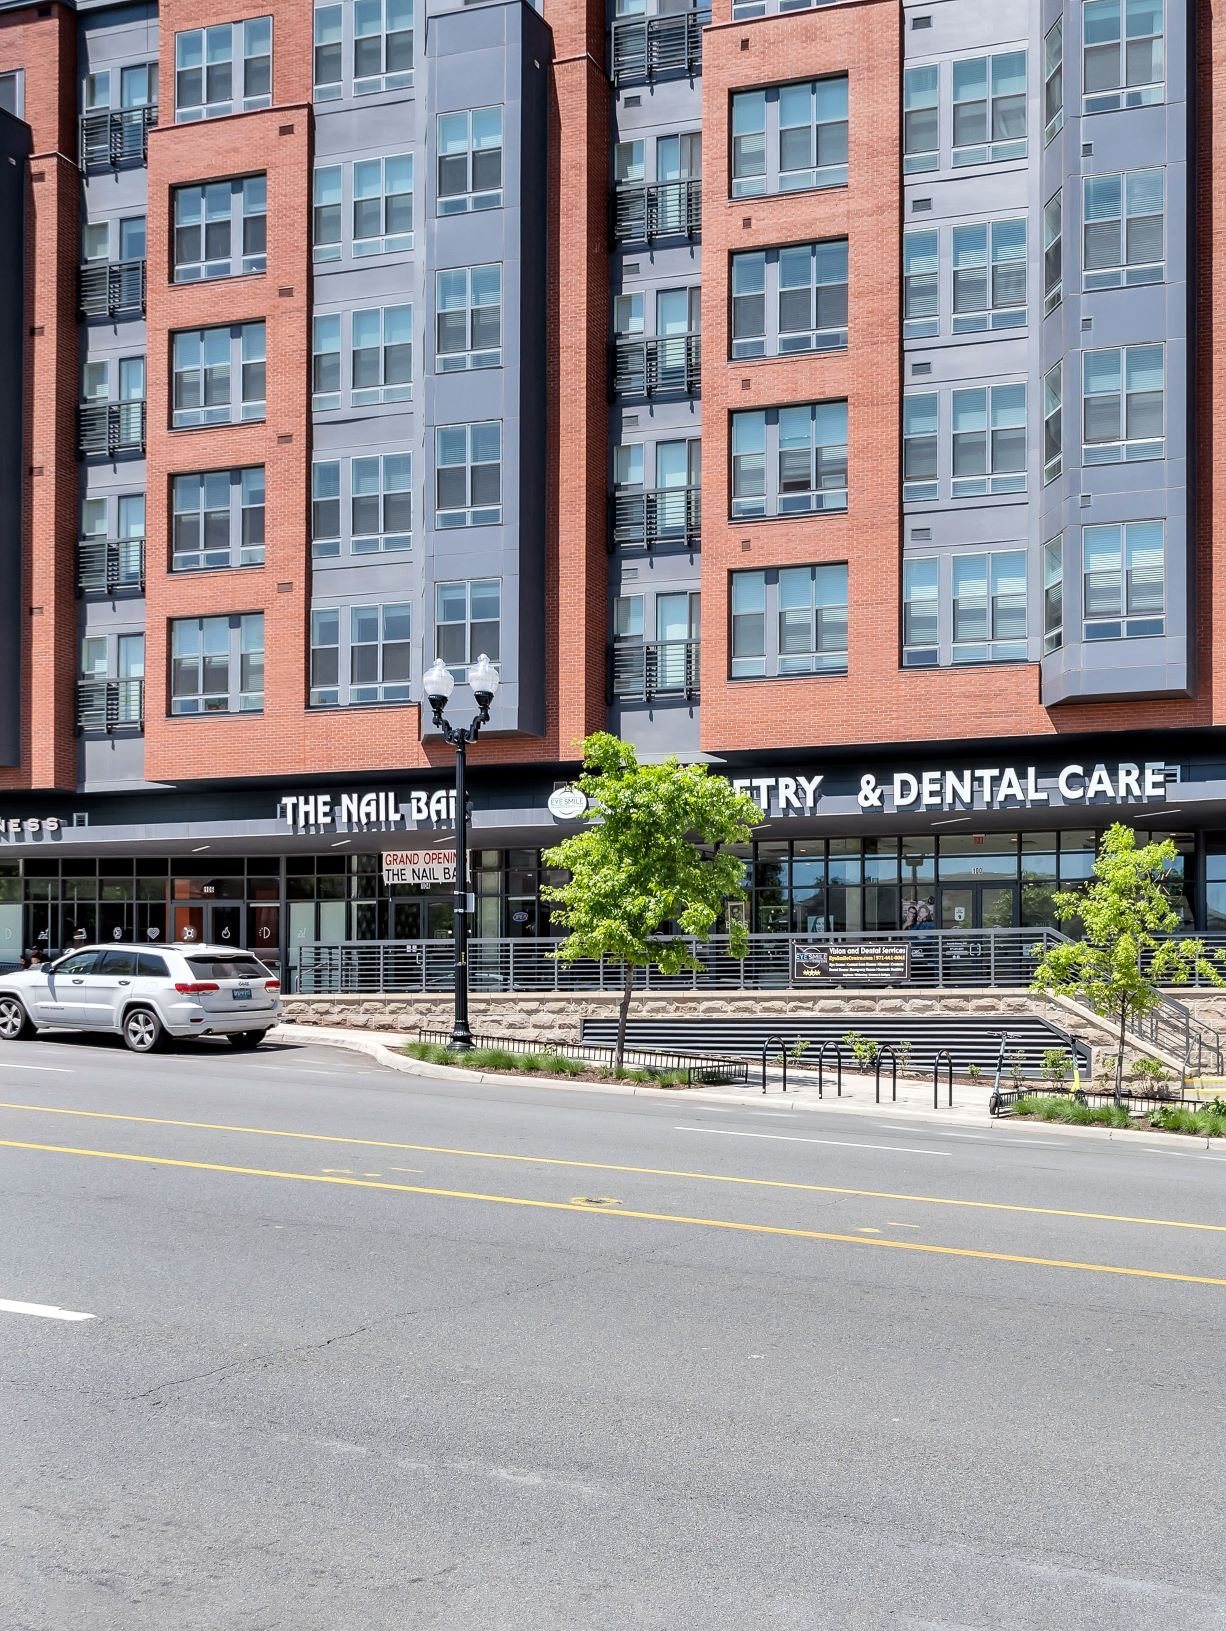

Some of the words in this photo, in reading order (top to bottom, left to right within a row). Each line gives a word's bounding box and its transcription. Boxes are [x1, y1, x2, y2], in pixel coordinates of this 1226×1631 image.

[857, 773, 882, 808] &
[893, 766, 1048, 806] DENTAL
[1058, 761, 1166, 800] CARE
[281, 794, 333, 828] THE
[341, 791, 401, 826] NAIL
[550, 798, 563, 806] EYE
[385, 853, 420, 866] GRAND
[424, 851, 466, 865] OPENIN
[385, 868, 407, 882] THE
[411, 867, 440, 881] NAIL
[443, 866, 457, 880] BA
[726, 920, 749, 930] BSS
[861, 946, 880, 954] Dental
[882, 945, 906, 954] Services
